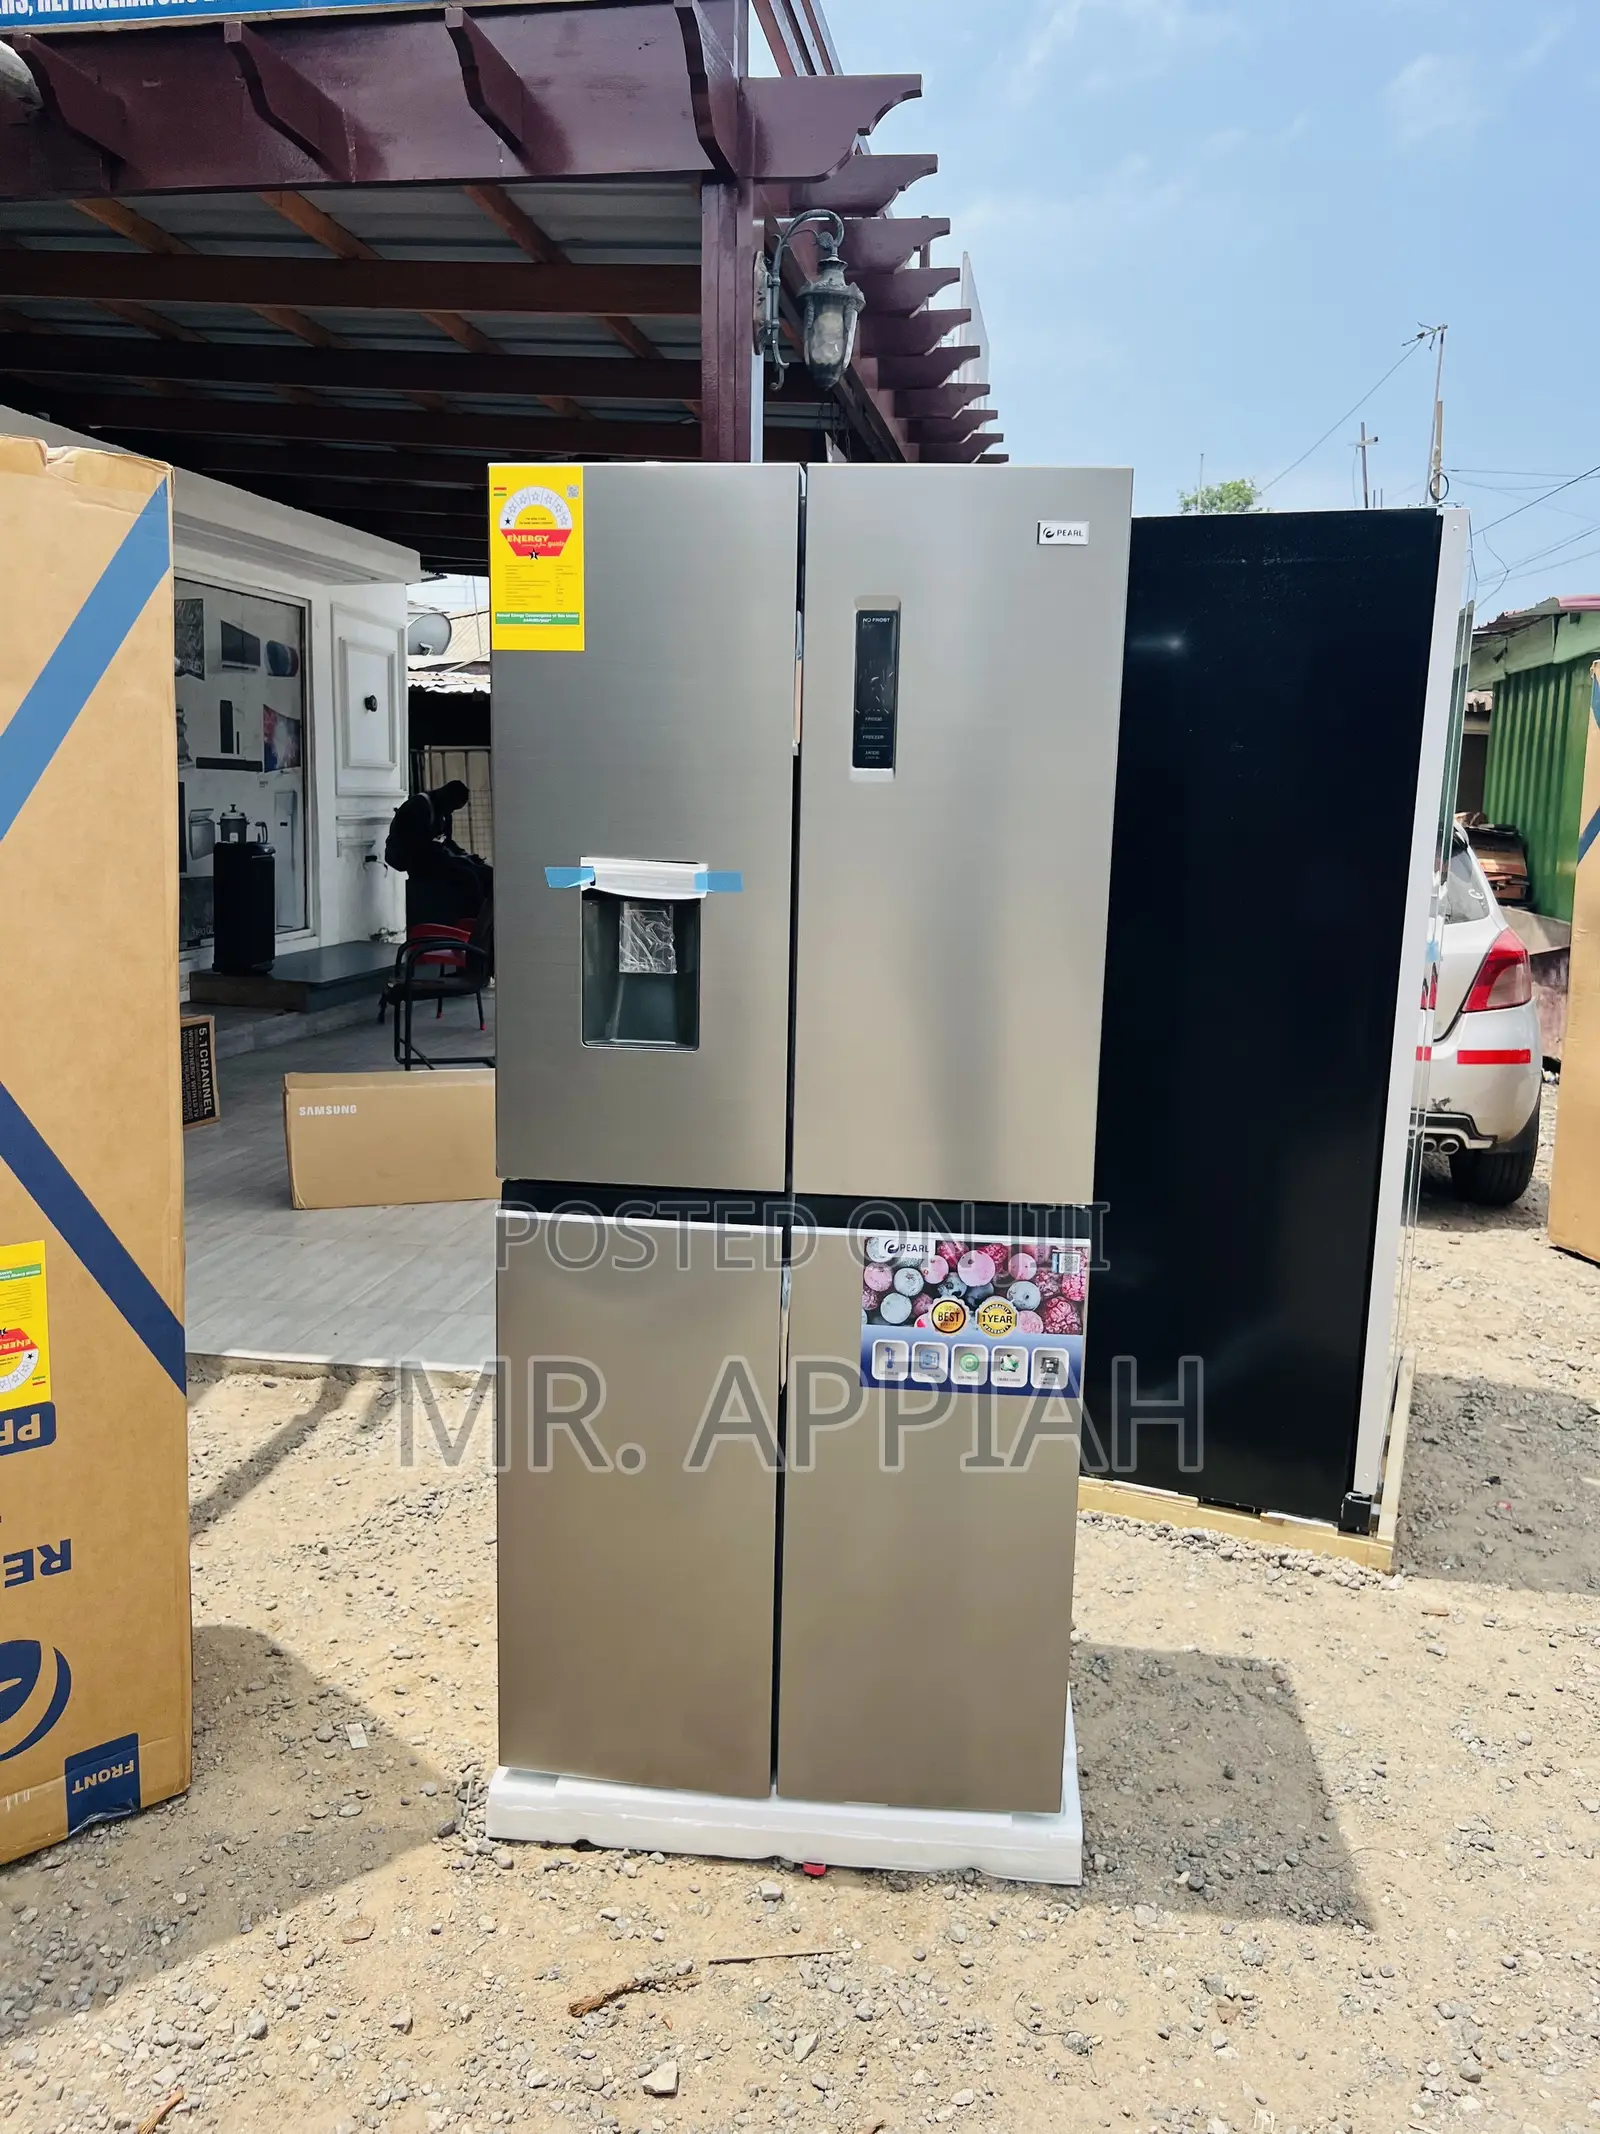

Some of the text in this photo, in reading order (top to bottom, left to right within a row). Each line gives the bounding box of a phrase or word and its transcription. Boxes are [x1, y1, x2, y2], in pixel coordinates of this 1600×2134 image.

[1056, 528, 1084, 537] PEARL
[507, 533, 549, 544] ENERGY
[188, 1049, 196, 1079] SYNERGY
[193, 1108, 199, 1117] TV
[299, 1104, 357, 1116] SAMSUNG
[899, 1243, 930, 1253] PEARL
[937, 1312, 960, 1322] BEST
[981, 1314, 1013, 1323] 1 YEAR
[72, 1759, 135, 1794] FRONT
